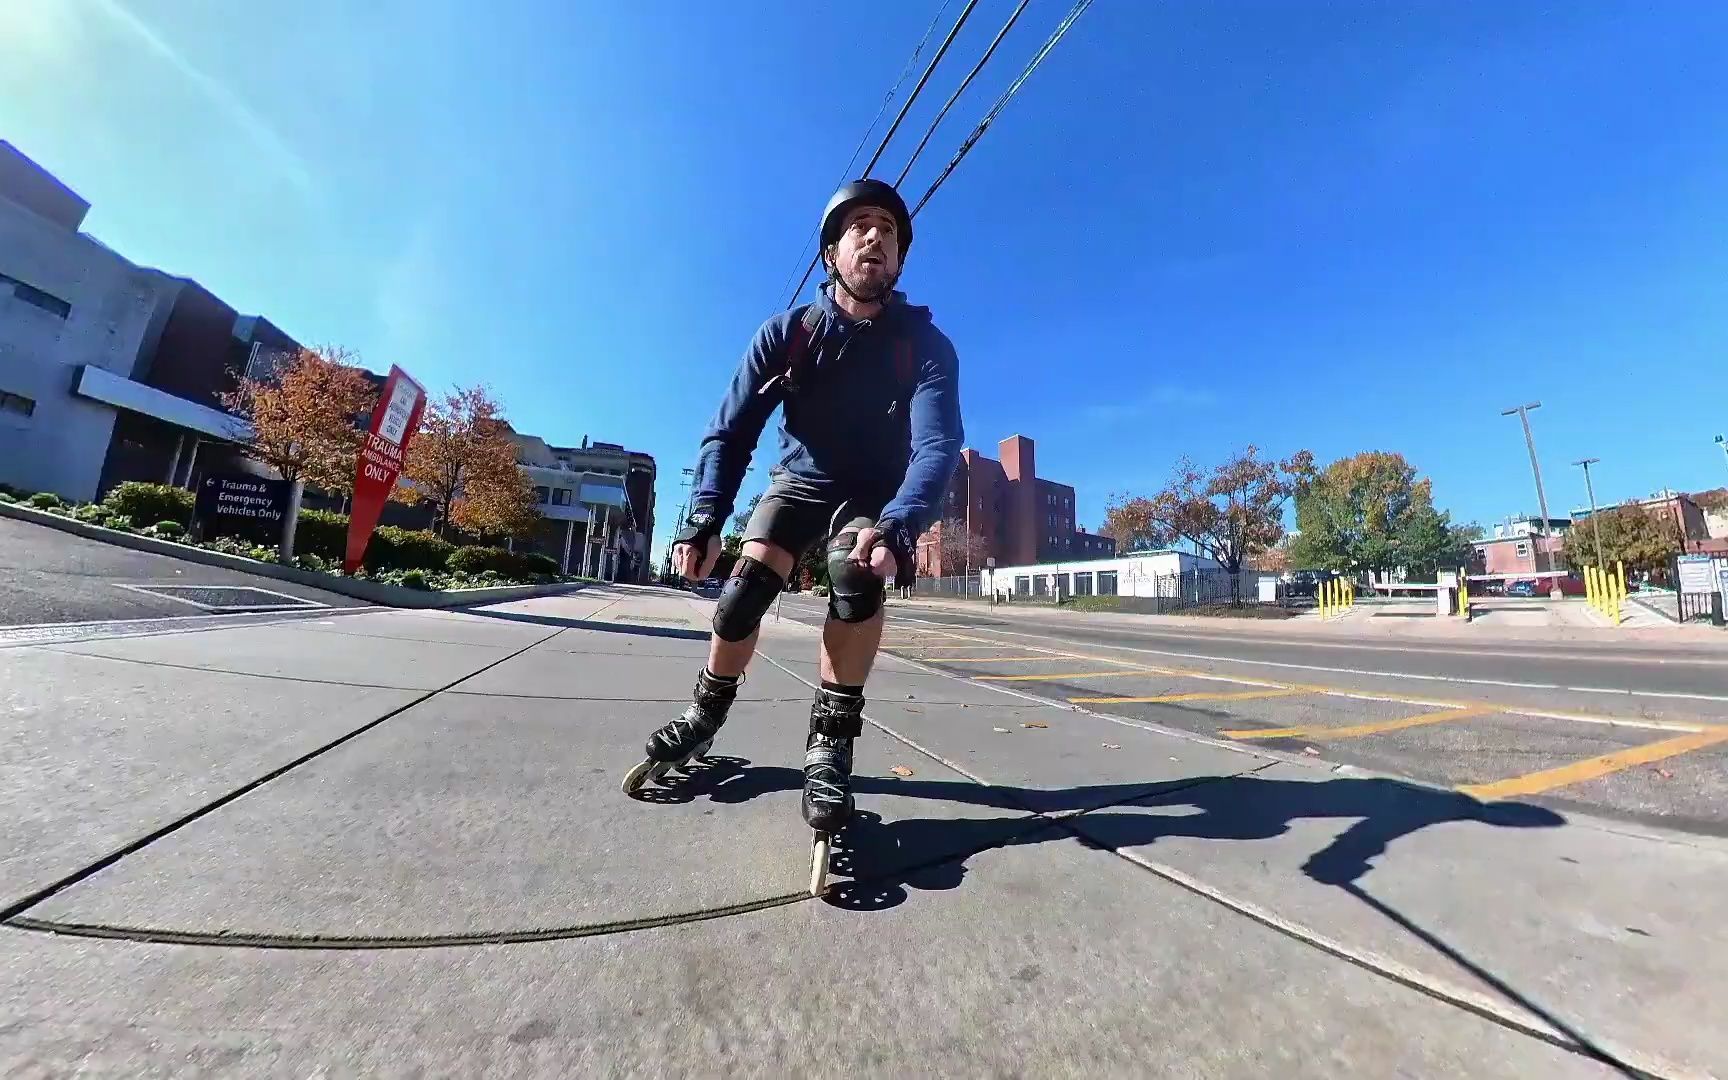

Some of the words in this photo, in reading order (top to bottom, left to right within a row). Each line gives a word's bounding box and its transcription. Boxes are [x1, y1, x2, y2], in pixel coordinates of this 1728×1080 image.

[367, 433, 402, 461] TRAUMA
[362, 449, 400, 472] AMBULANCE
[364, 463, 390, 483] ONLY
[222, 479, 257, 491] Trauma
[259, 483, 267, 493] &
[218, 492, 273, 508] Emergency
[217, 504, 256, 516] Vehicles
[258, 509, 281, 520] Only
